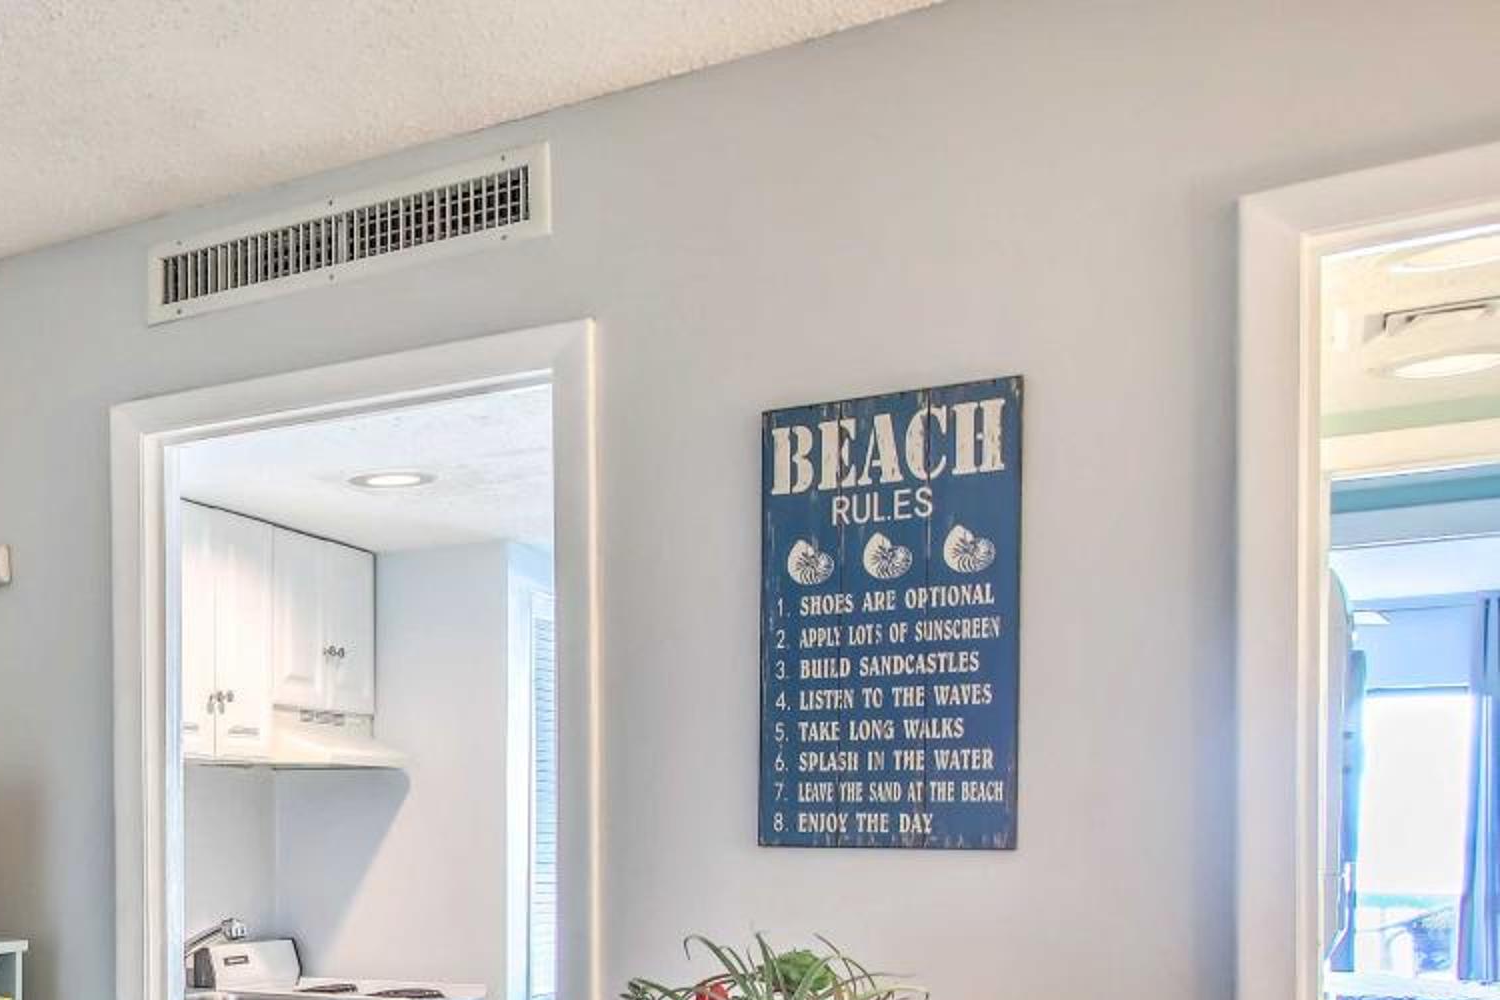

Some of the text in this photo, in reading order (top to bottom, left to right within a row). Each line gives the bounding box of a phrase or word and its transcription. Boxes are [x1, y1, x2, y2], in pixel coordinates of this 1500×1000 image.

[771, 398, 1006, 495] BEACH
[832, 487, 933, 525] RULES
[800, 594, 854, 616] SHOES
[862, 590, 895, 611] ARE
[905, 584, 995, 609] OPTIONAL
[800, 627, 841, 649] APPLY
[849, 624, 883, 646] LOTS
[889, 623, 908, 643] OF
[915, 617, 1000, 641] SUNSCREEN
[800, 658, 851, 679] BUILD
[859, 652, 980, 677] SANDCASTLES
[800, 688, 854, 711] LISTEN
[863, 687, 883, 708] TO
[892, 686, 924, 706] THE
[934, 684, 993, 705] WAVES
[798, 721, 840, 742] TAKE
[850, 720, 894, 740] LONG
[903, 718, 965, 739] WALKS
[799, 751, 858, 771] SPLASH
[867, 751, 884, 770] IN
[893, 750, 924, 770] THE
[934, 749, 994, 769] WATER
[798, 782, 834, 802] LEAVE
[839, 782, 863, 802] THE
[869, 782, 901, 802] SAND
[907, 782, 923, 802] AT
[930, 782, 954, 801] THE
[961, 781, 1003, 802] BEACH
[798, 814, 848, 833] ENJOY
[856, 814, 889, 832] THE
[899, 814, 933, 834] DAY
